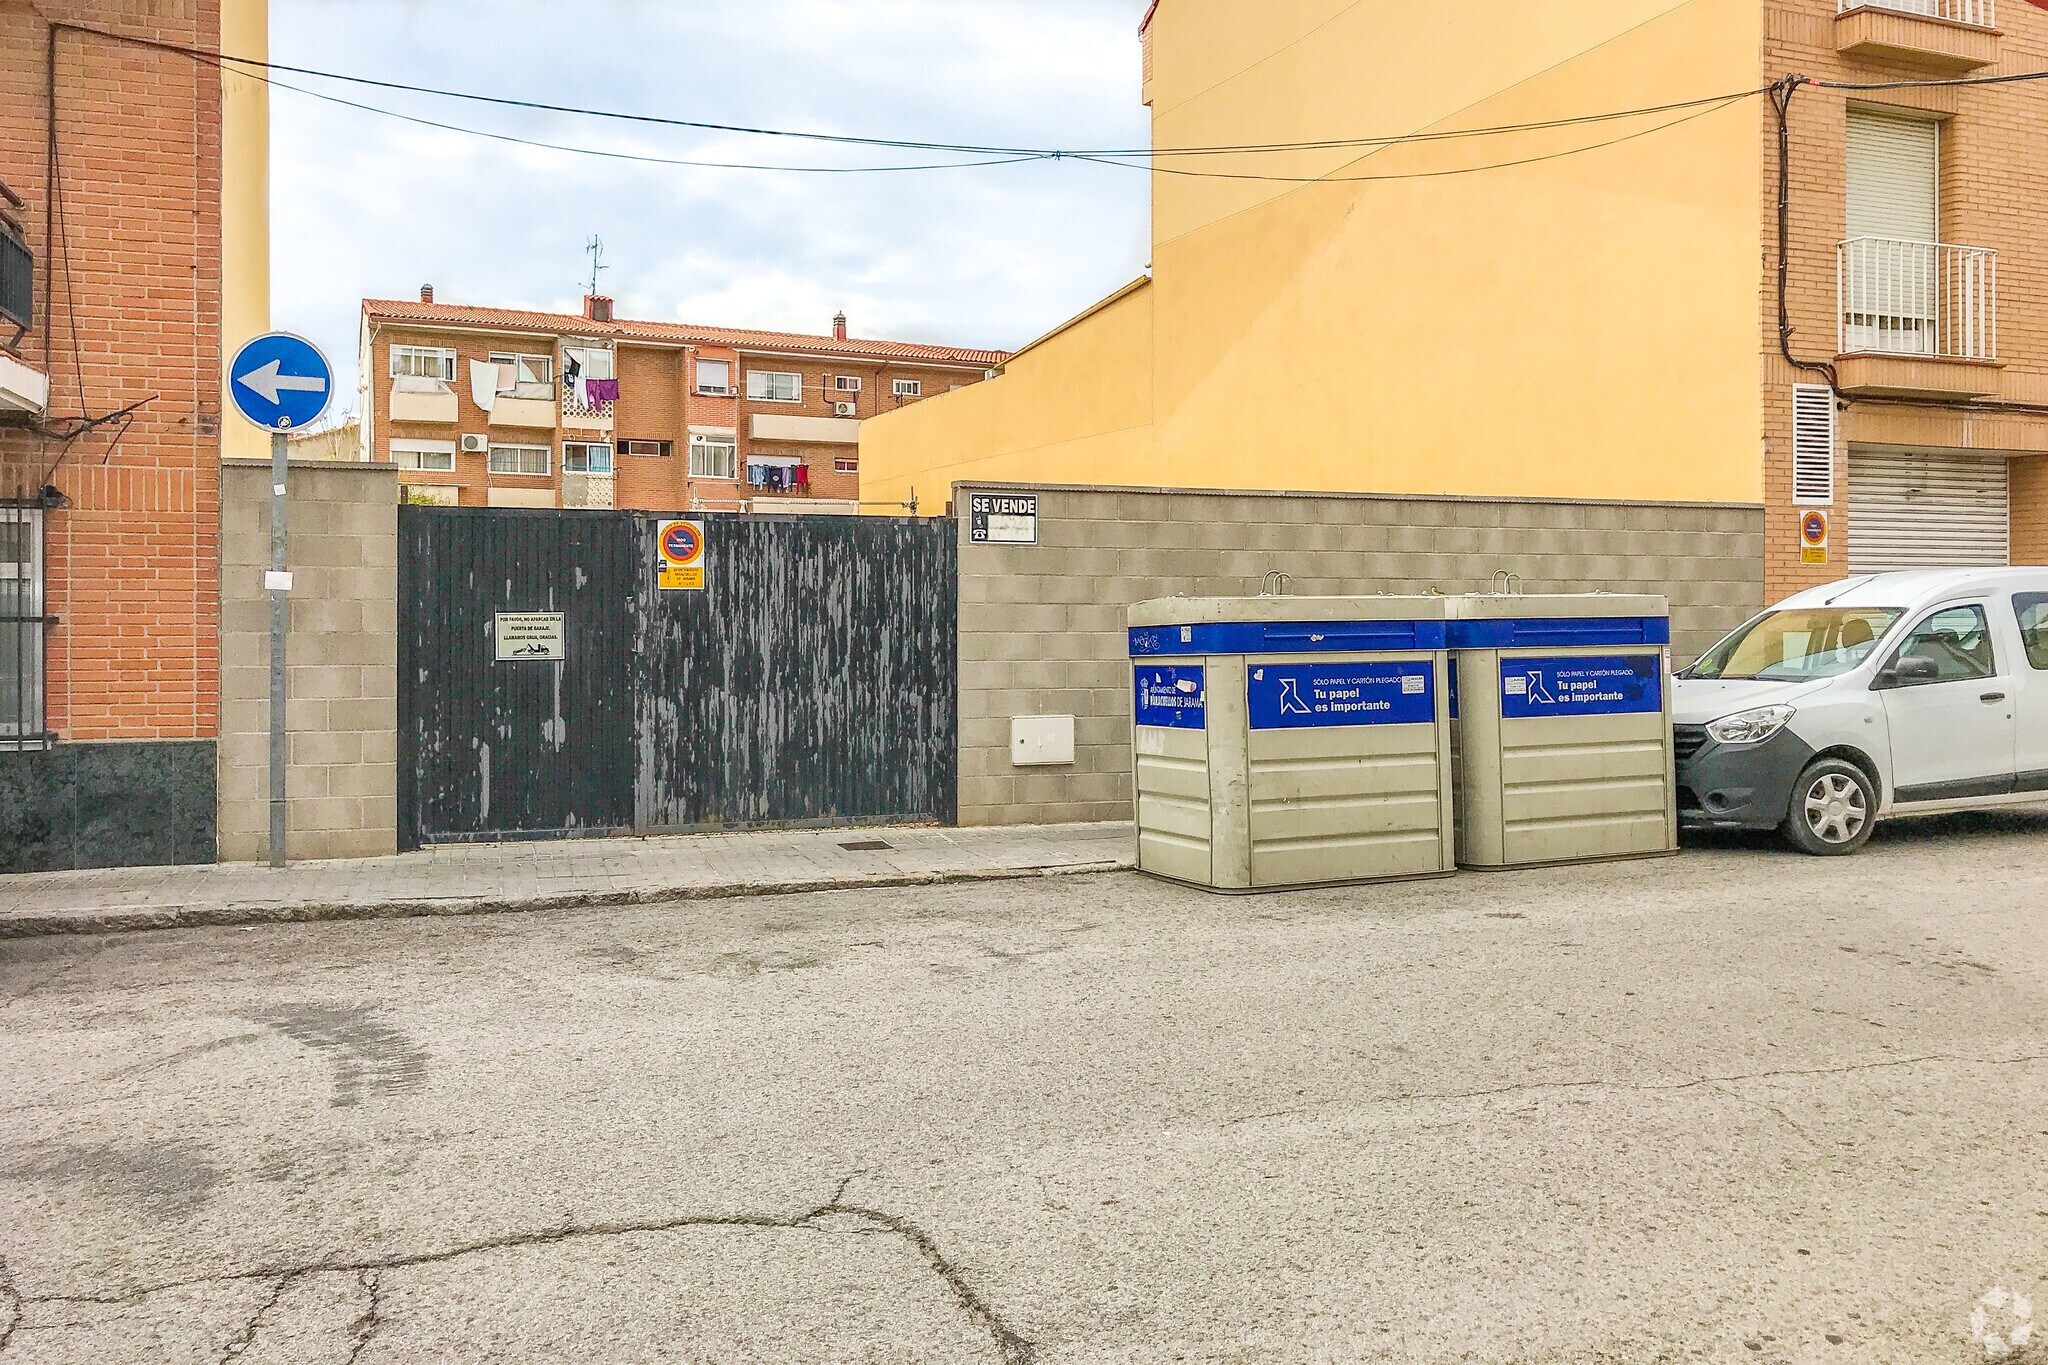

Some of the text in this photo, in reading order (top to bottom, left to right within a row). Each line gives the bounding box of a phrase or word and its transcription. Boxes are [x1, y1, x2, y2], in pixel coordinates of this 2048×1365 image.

[973, 498, 1035, 514] SE VENDE
[1313, 677, 1329, 686] SÓLO
[1330, 677, 1346, 685] PAPEL
[1351, 676, 1375, 684] CARTÓN
[1376, 676, 1402, 684] PLEGADO
[1557, 679, 1597, 691] Tu papel
[1313, 687, 1360, 700] Tu papel
[1558, 691, 1624, 703] es importante
[1177, 696, 1183, 708] DE
[1183, 696, 1204, 709] JARAMA
[1314, 700, 1391, 713] es importante
